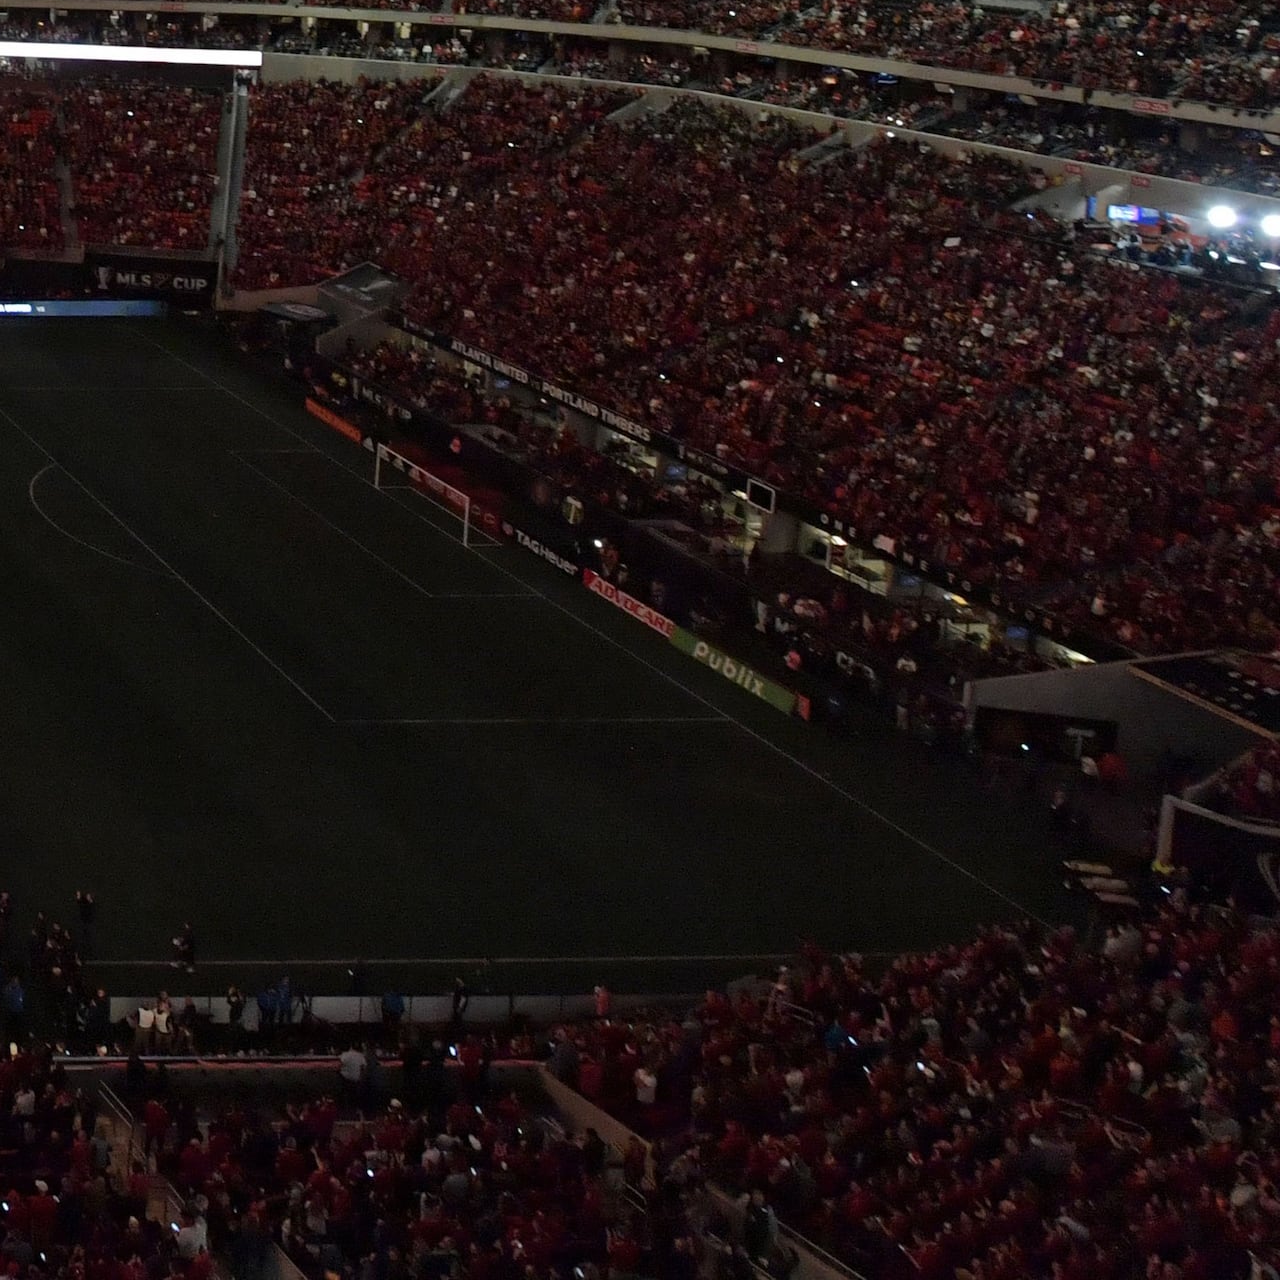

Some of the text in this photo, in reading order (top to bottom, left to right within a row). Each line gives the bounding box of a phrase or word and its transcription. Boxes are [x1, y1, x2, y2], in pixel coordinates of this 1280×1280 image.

[116, 272, 209, 291] MLS CUP
[451, 339, 491, 366] ATLANTA
[492, 358, 529, 385] UNITED
[542, 380, 600, 419] PORTLAND
[600, 407, 652, 443] TIMBERS
[694, 640, 765, 698] Publix
